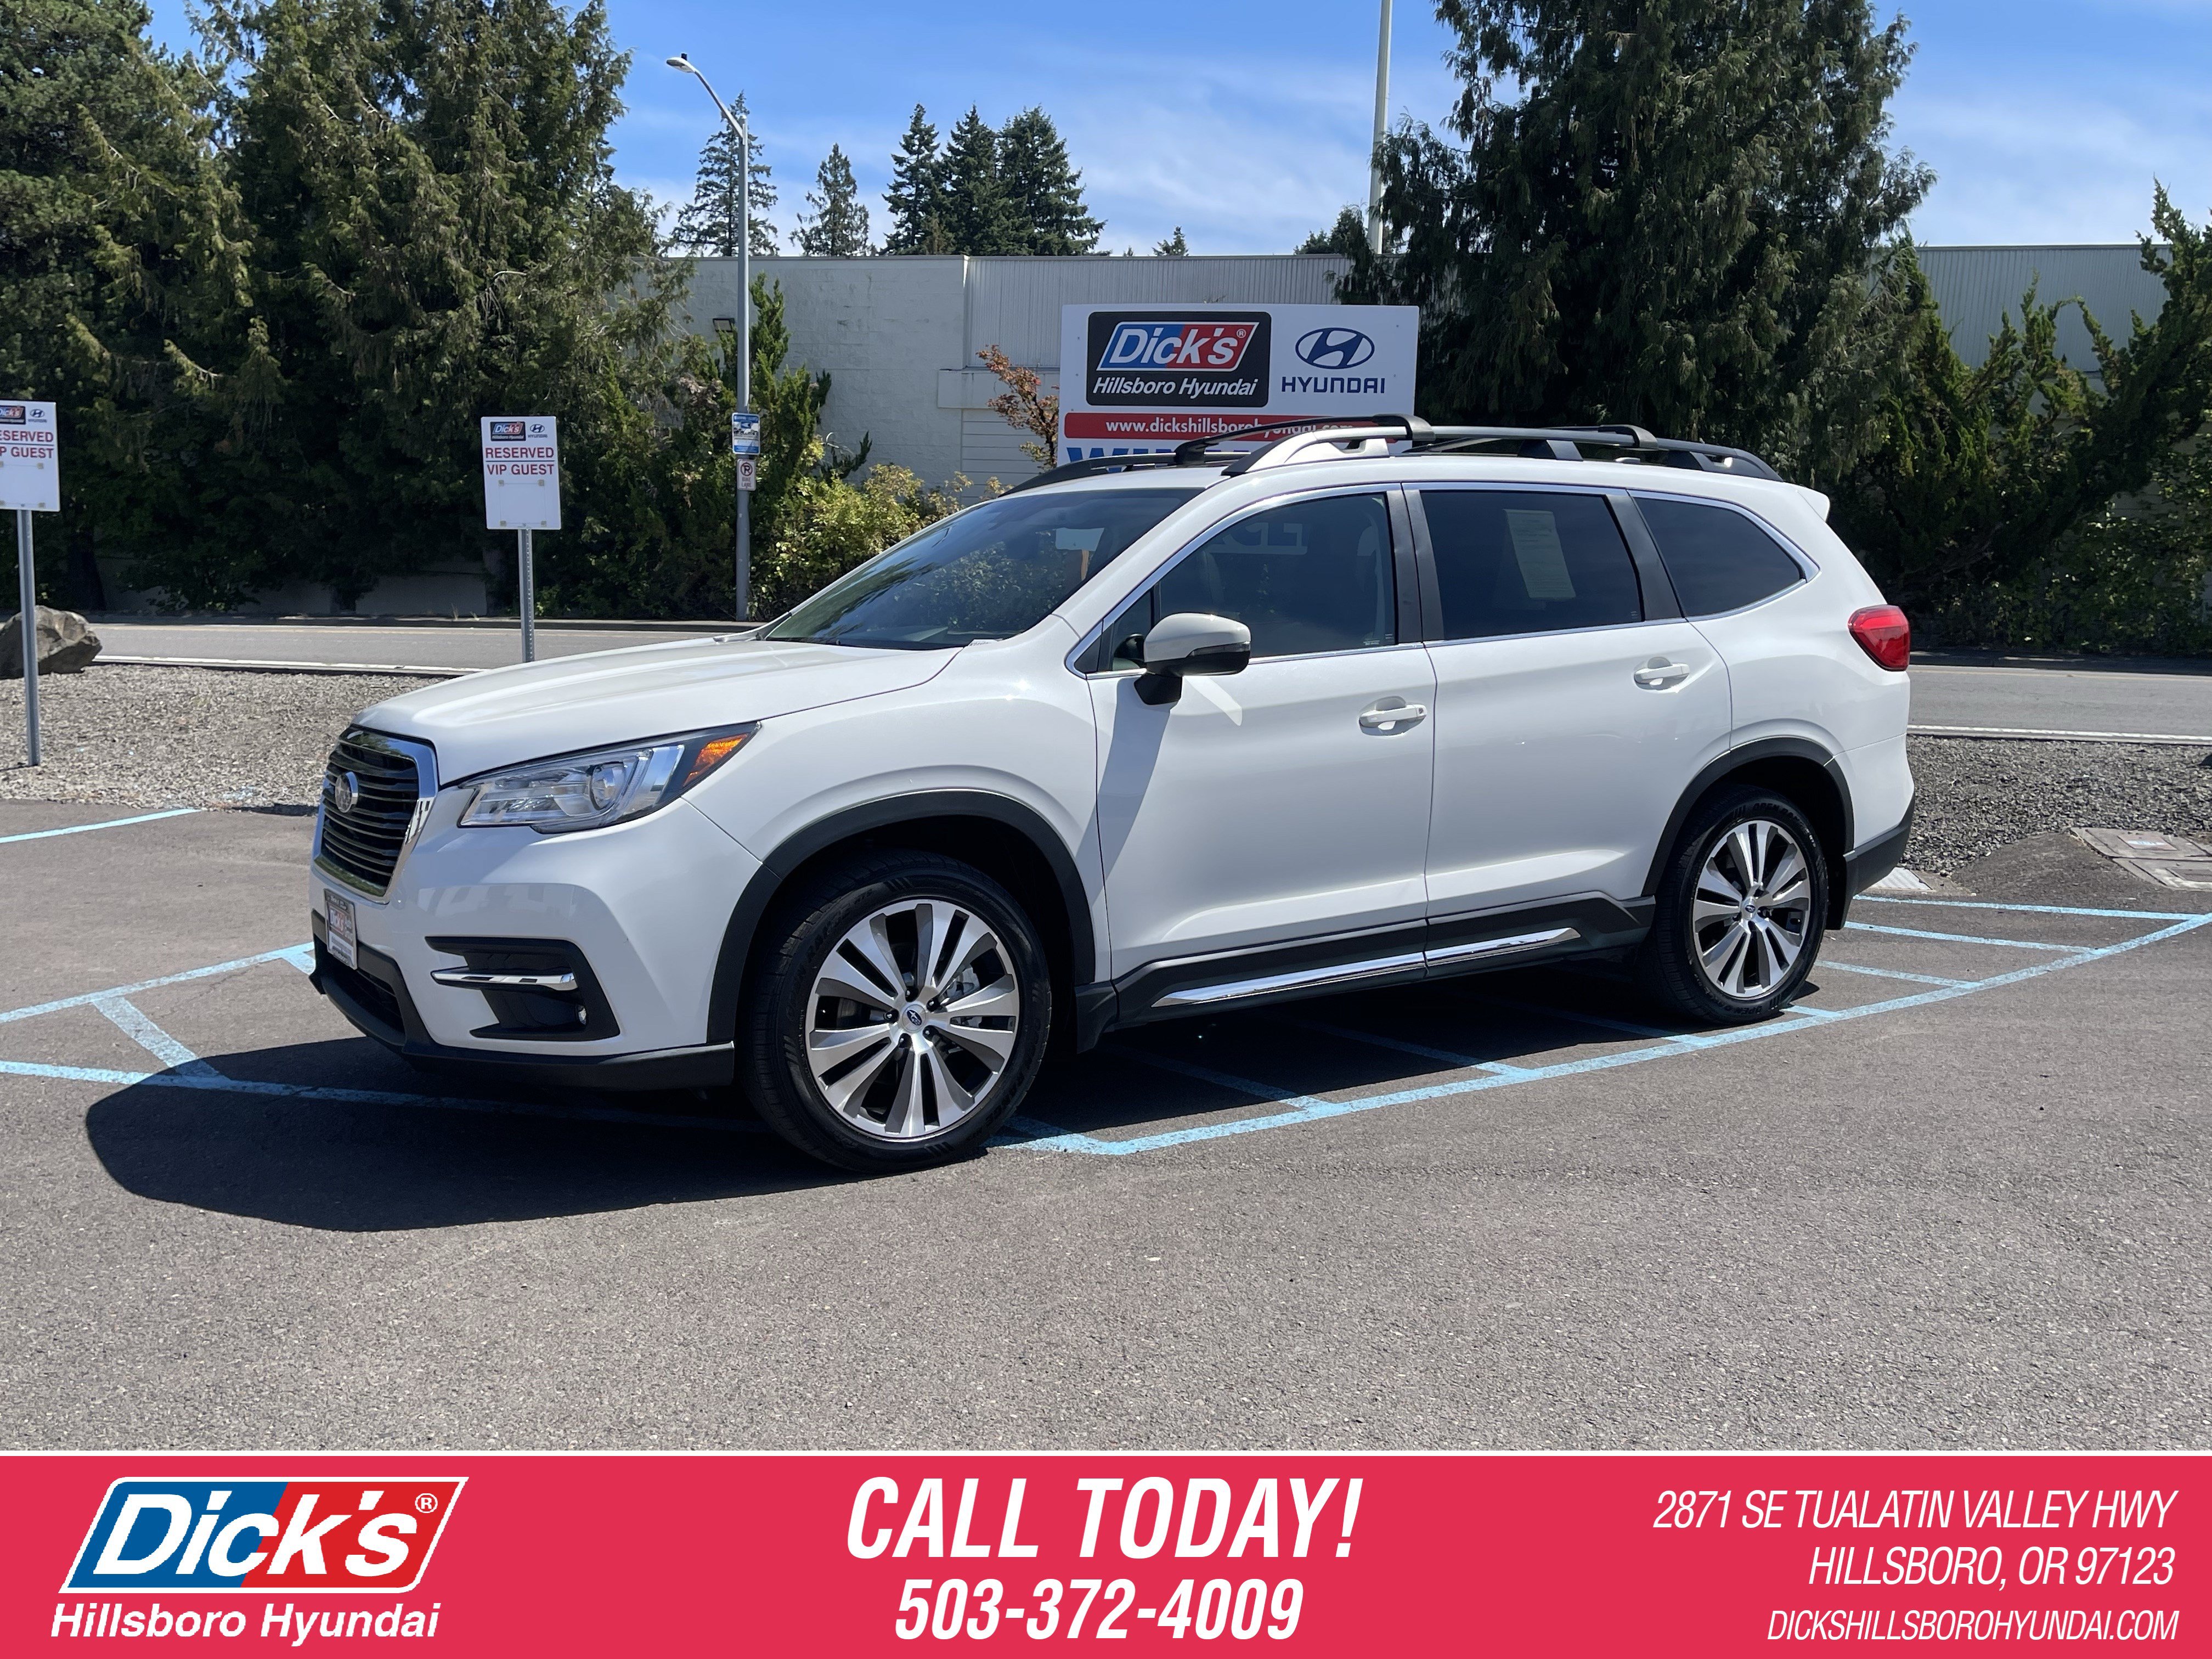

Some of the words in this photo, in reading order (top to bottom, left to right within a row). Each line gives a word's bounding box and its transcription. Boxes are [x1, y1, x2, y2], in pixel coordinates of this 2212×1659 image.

[1109, 328, 1238, 365] Dick's
[1093, 377, 1176, 394] Hillsboro
[1178, 377, 1258, 399] Hyundai
[1282, 376, 1385, 394] HYUNDAI
[0, 430, 53, 442] SERVED
[11, 447, 54, 459] GUEST
[486, 447, 554, 459] RESERVED
[487, 464, 507, 475] VIP
[511, 464, 554, 475] GUEST
